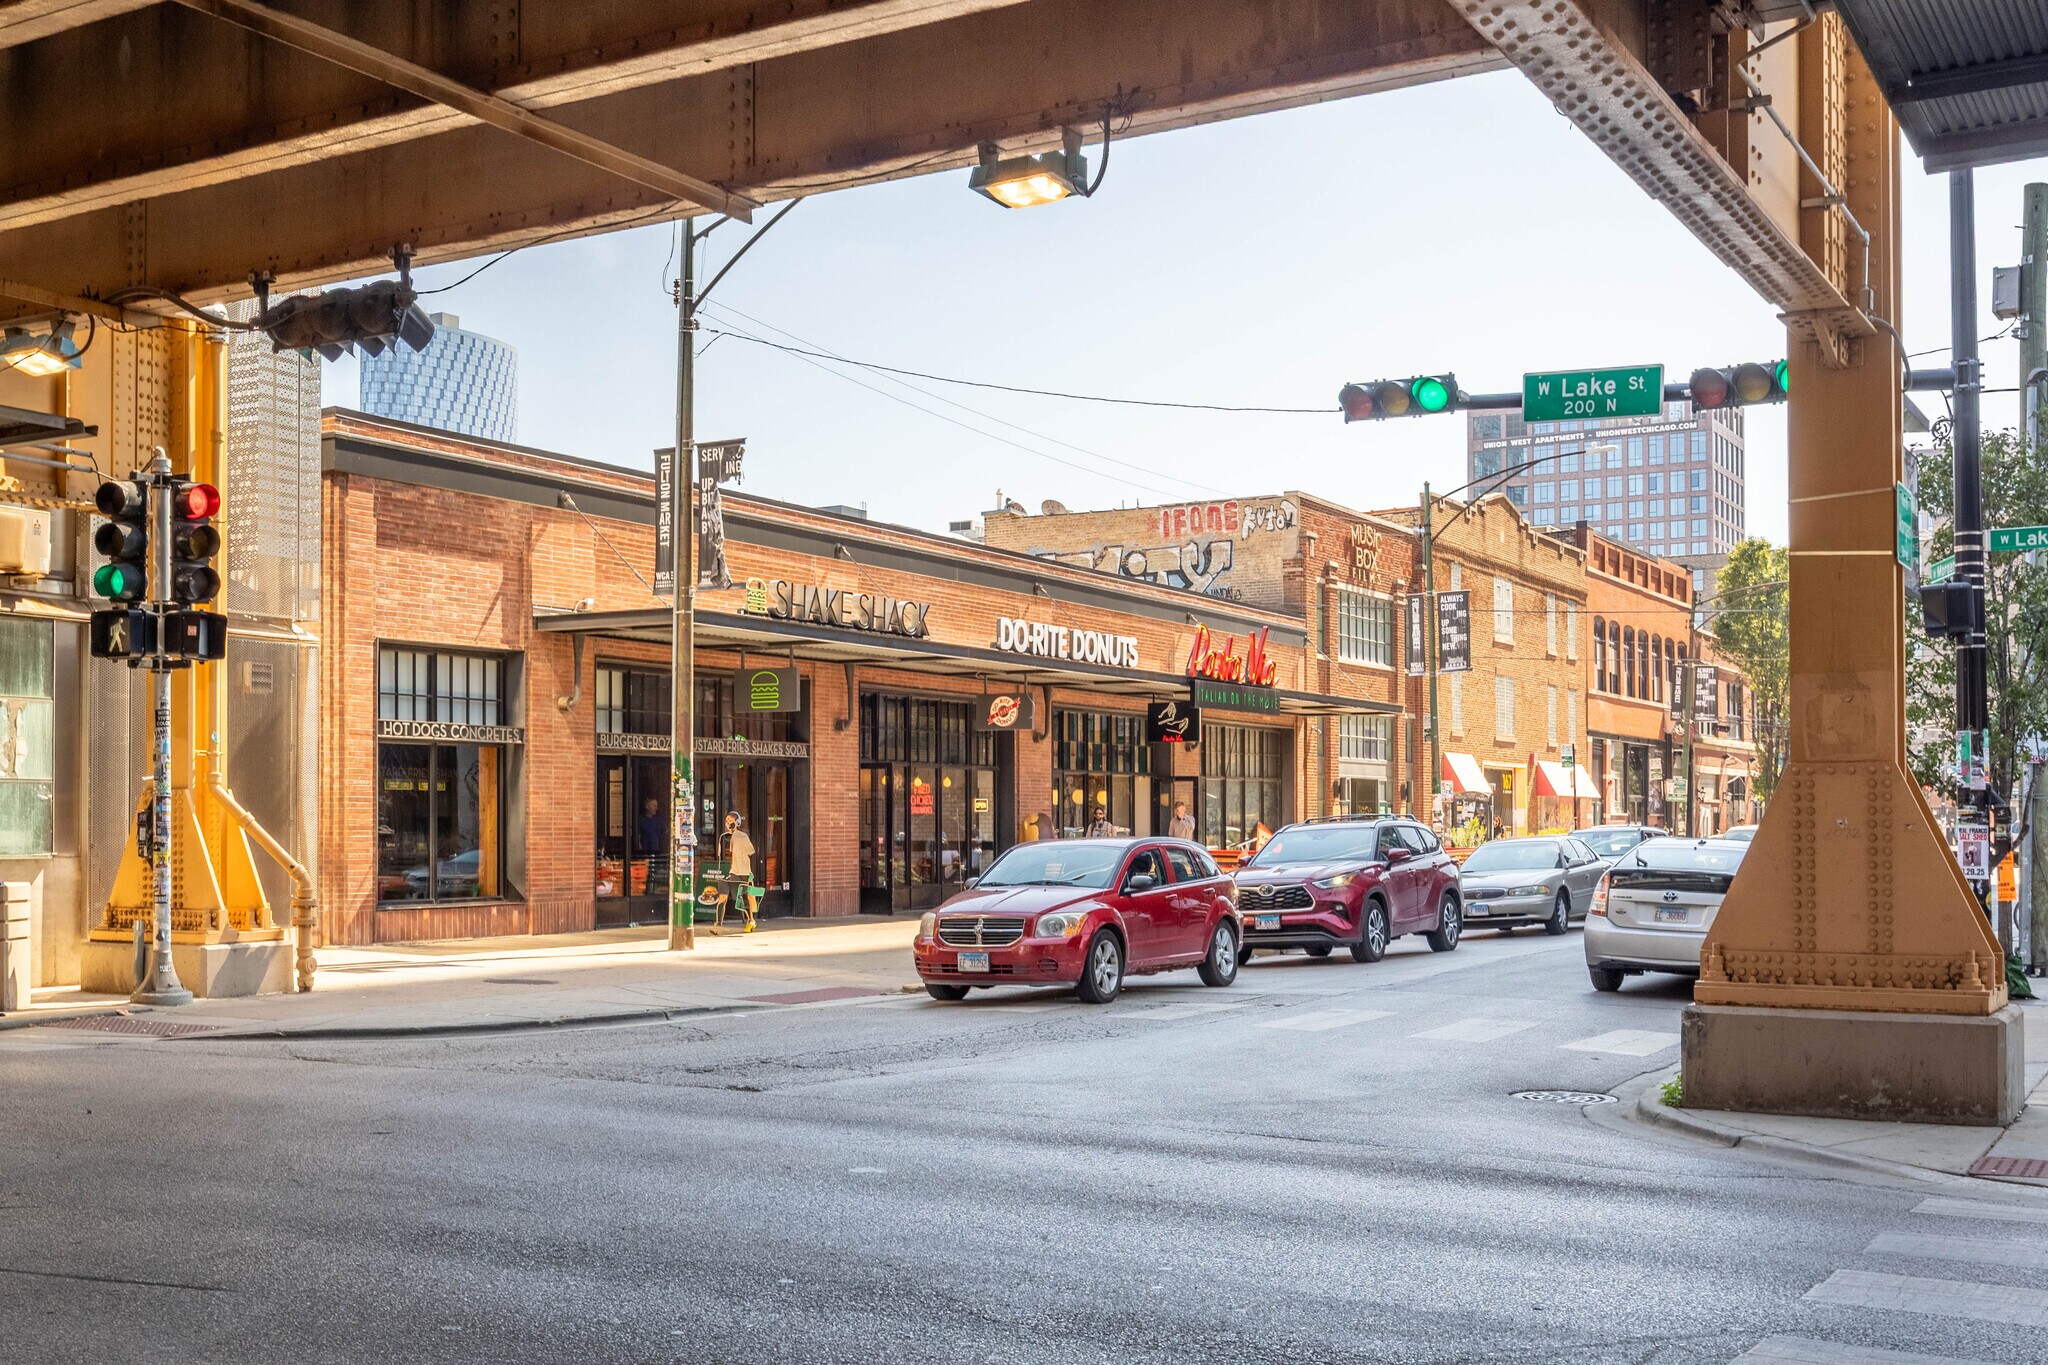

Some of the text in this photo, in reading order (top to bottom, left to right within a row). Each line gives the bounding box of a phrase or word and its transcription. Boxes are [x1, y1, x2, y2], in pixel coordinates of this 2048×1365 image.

[1538, 375, 1645, 398] W Lake St
[1564, 397, 1617, 415] 200 N
[1483, 441, 1507, 450] UNION
[1510, 438, 1532, 447] WEST
[1535, 433, 1585, 445] APARTMENTS
[1595, 422, 1698, 438] UNIONWESTCHICAGO.COM
[701, 447, 725, 462] SERV
[725, 459, 742, 474] ING
[701, 477, 714, 491] UP
[659, 454, 671, 547] FULTON MARKET
[1350, 523, 1383, 553] MUSIC
[2000, 530, 2048, 547] W Lak
[1355, 546, 1379, 571] BOX
[655, 571, 670, 581] WCA
[1352, 566, 1382, 586] FILMS
[1440, 594, 1464, 604] ALWAYS
[1440, 603, 1457, 611] COOK
[768, 580, 931, 638] SHAKE SHACK
[1456, 610, 1467, 618] ING
[1441, 619, 1450, 627] UP
[1441, 627, 1458, 635] SOME
[997, 616, 1139, 668] DO-RITE DONUTS
[1187, 623, 1280, 687] Pasta Via
[1197, 688, 1227, 704] ITALIAN
[1231, 691, 1240, 705] ON
[1243, 693, 1256, 707] THE
[383, 721, 520, 741] HOT DOGS CONCRETES
[600, 734, 808, 757] BURGERS FROZ USTARD FRIES SHAKES SODA
[1502, 773, 1512, 789] 167
[975, 801, 987, 809] OPEN
